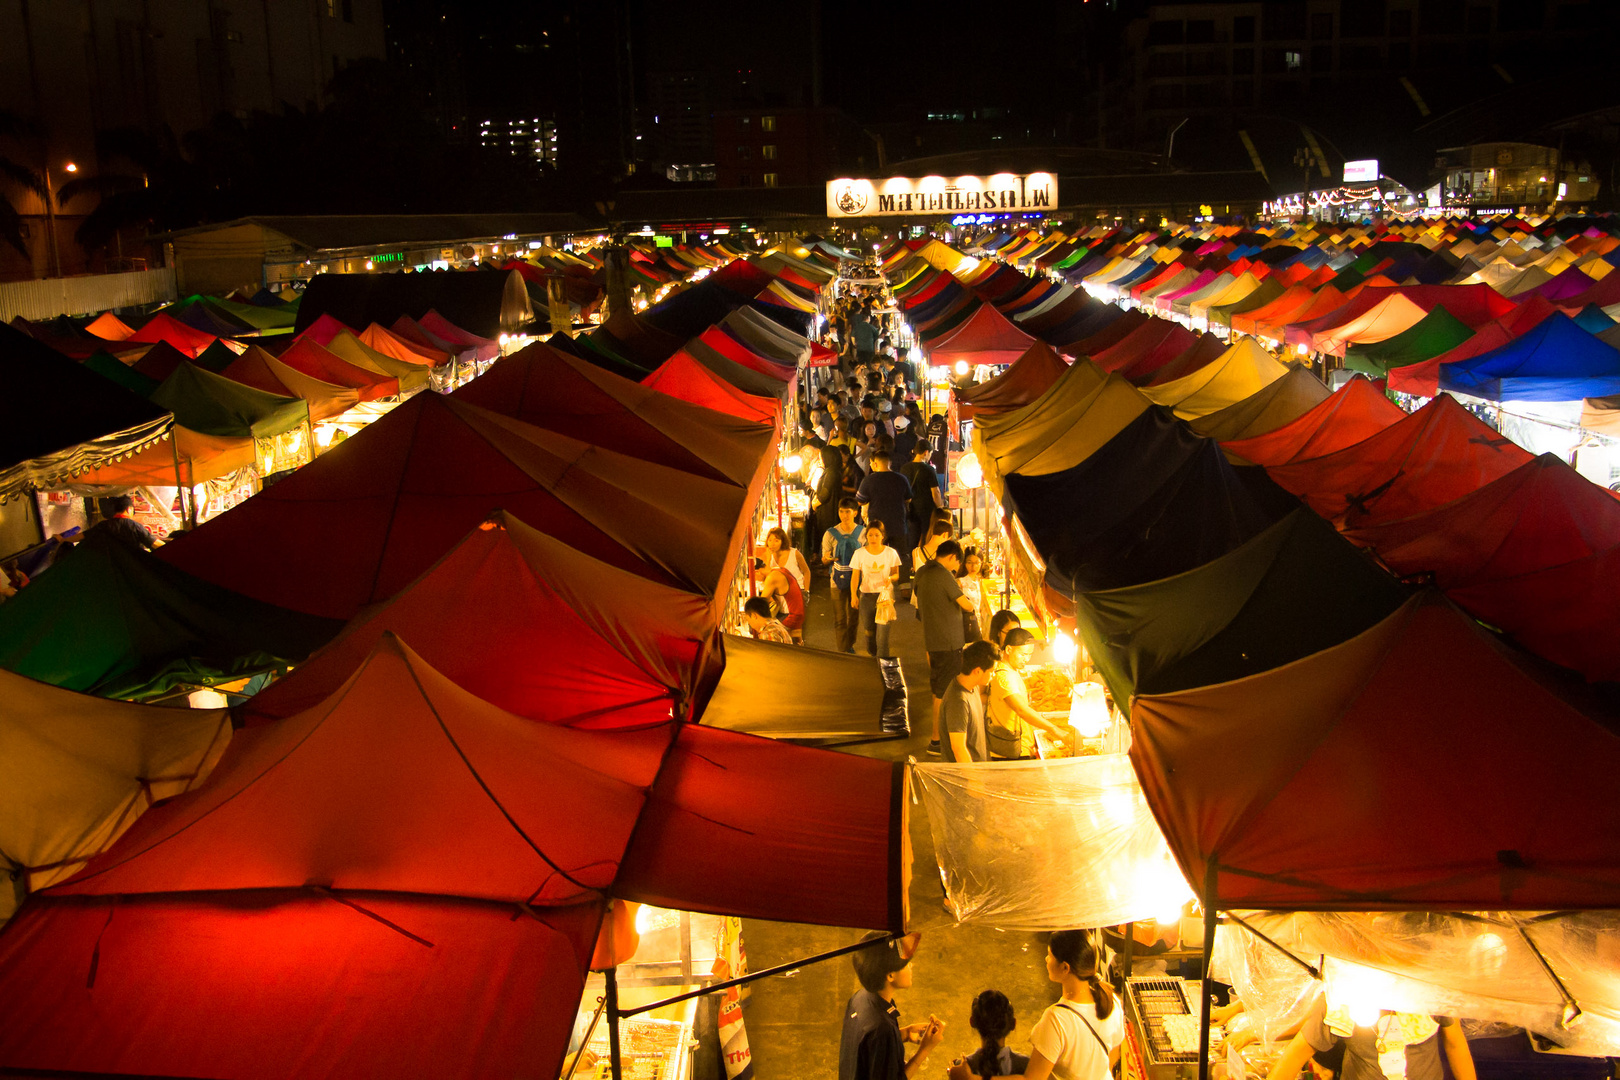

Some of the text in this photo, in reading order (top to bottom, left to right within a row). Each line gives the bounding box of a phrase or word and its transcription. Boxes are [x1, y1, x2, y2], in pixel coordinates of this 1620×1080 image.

[879, 176, 1050, 212] ตลาดนัดรถไฟ
